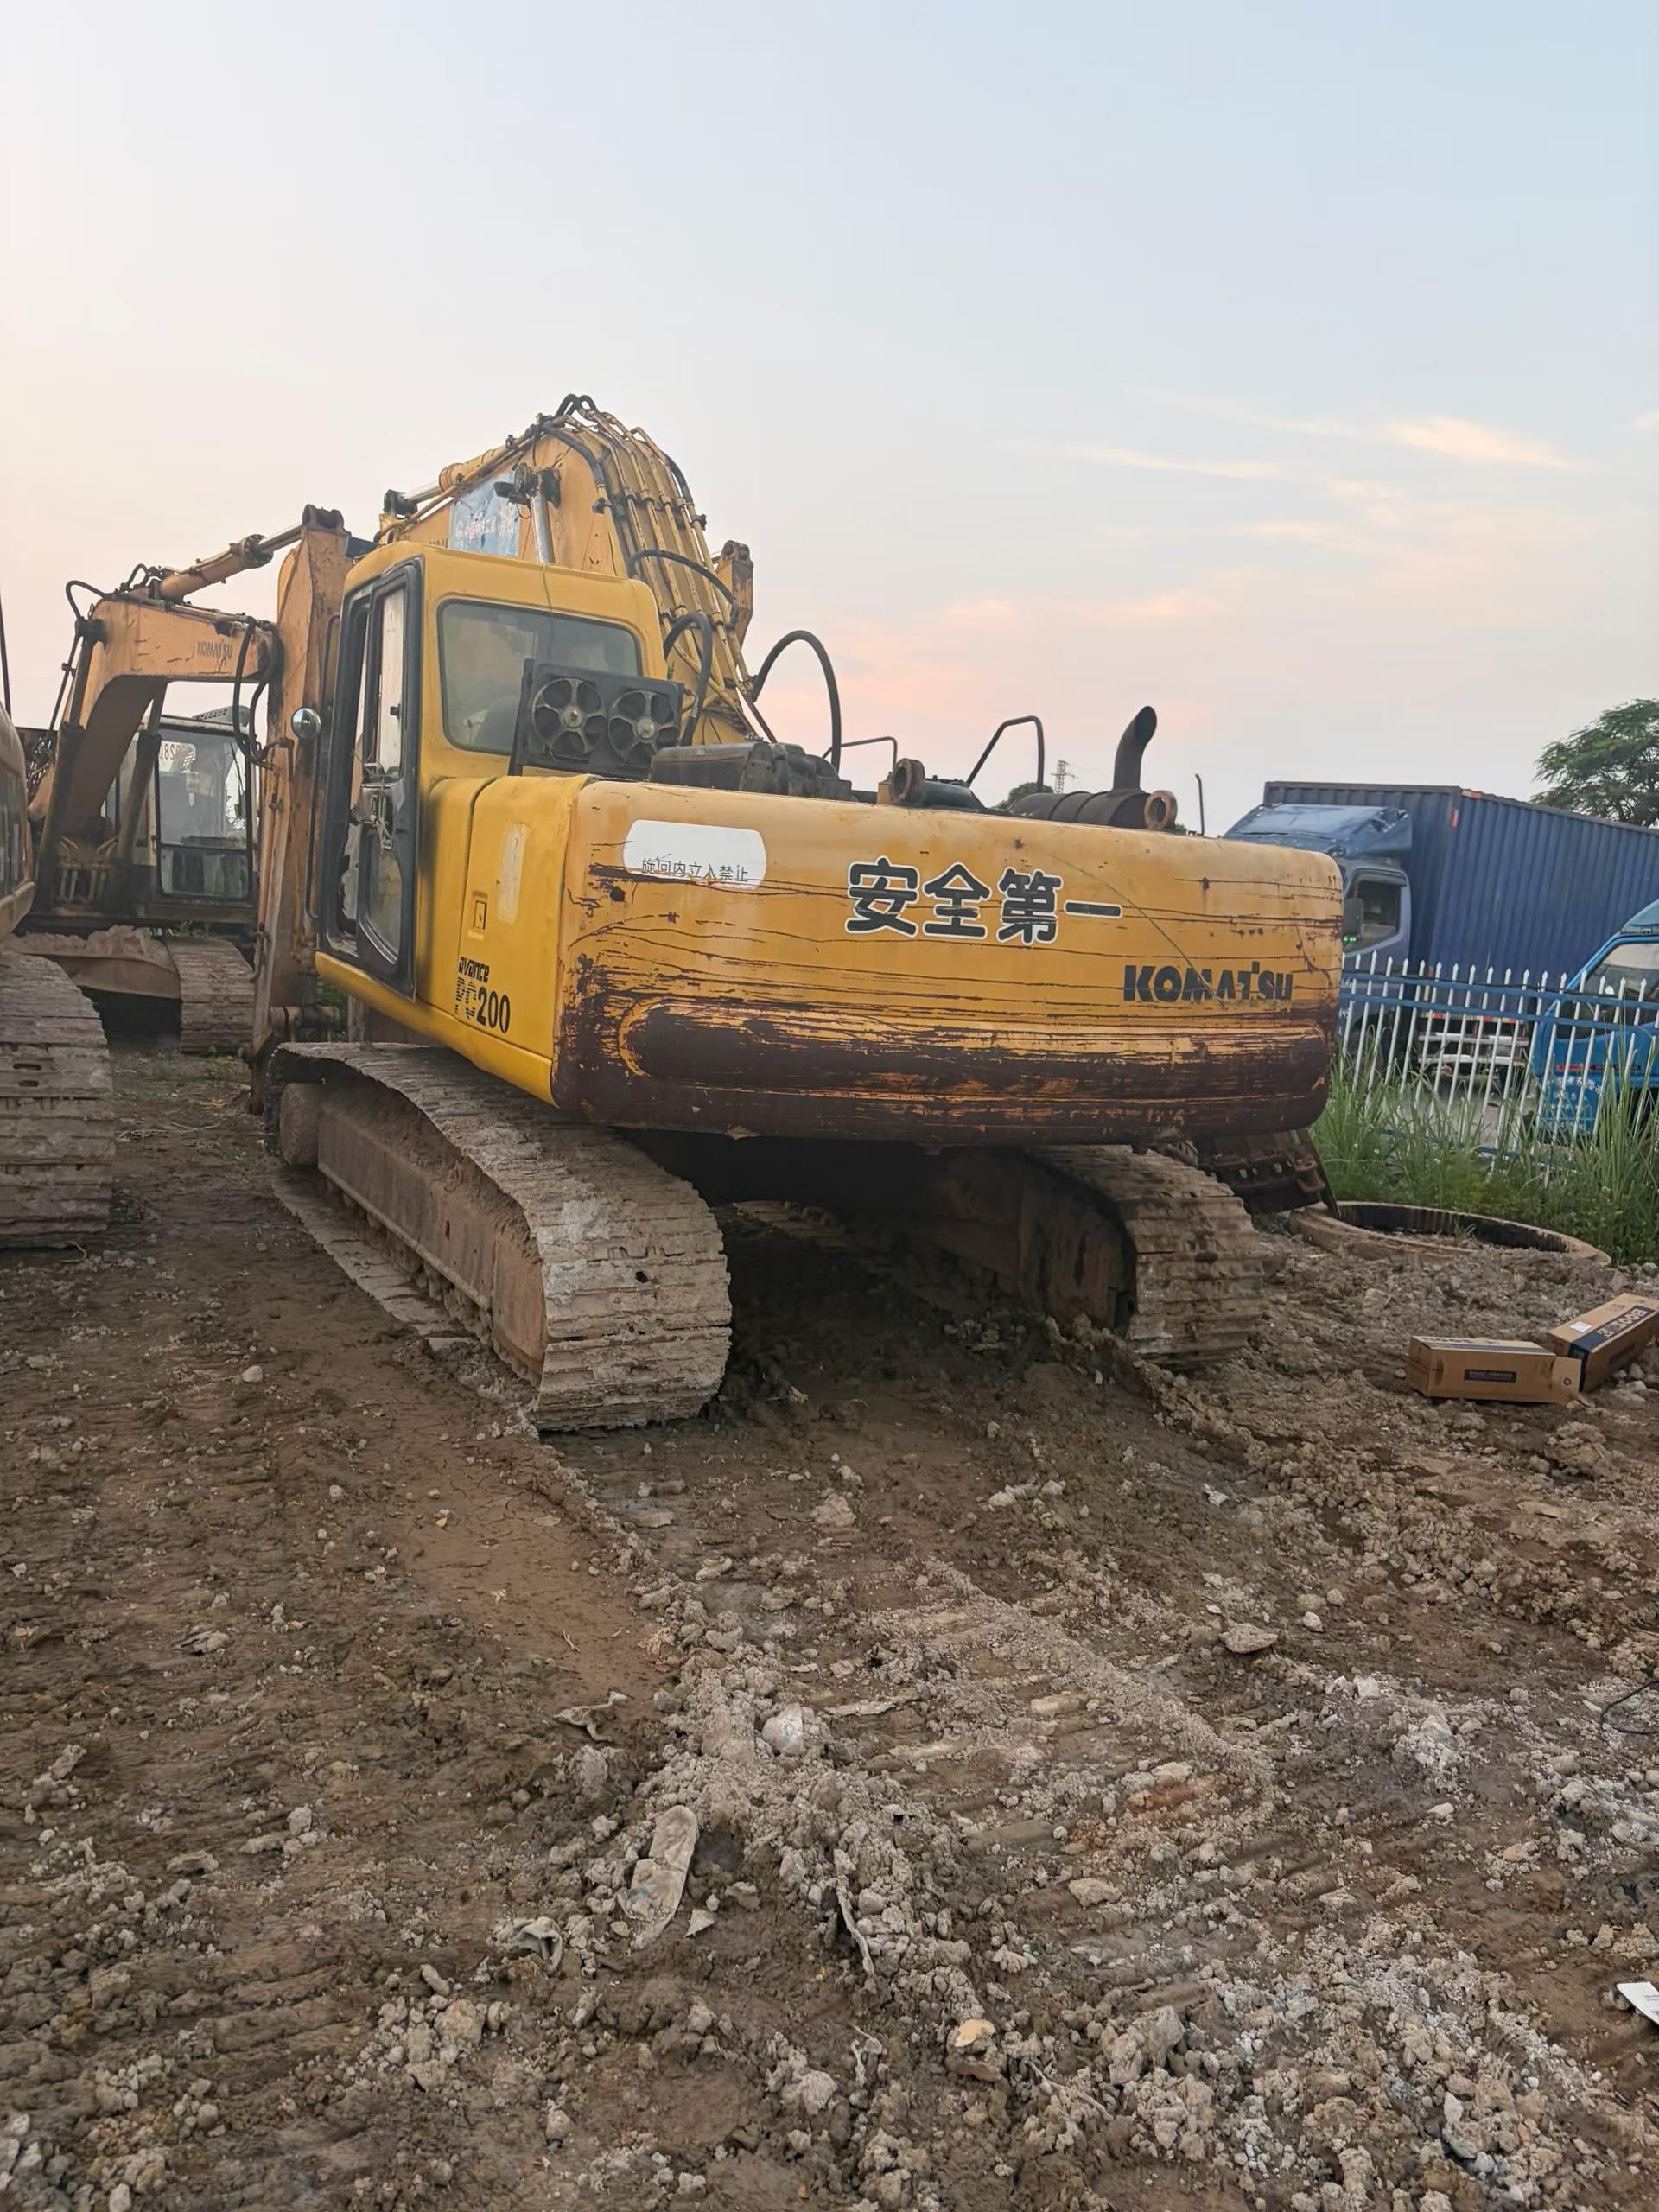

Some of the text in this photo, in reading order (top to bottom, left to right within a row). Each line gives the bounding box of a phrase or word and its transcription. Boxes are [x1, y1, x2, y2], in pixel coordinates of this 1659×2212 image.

[641, 857, 749, 883] 旋回内立入禁止
[845, 855, 1122, 945] 安全第一
[1123, 961, 1294, 1005] KOMATSU
